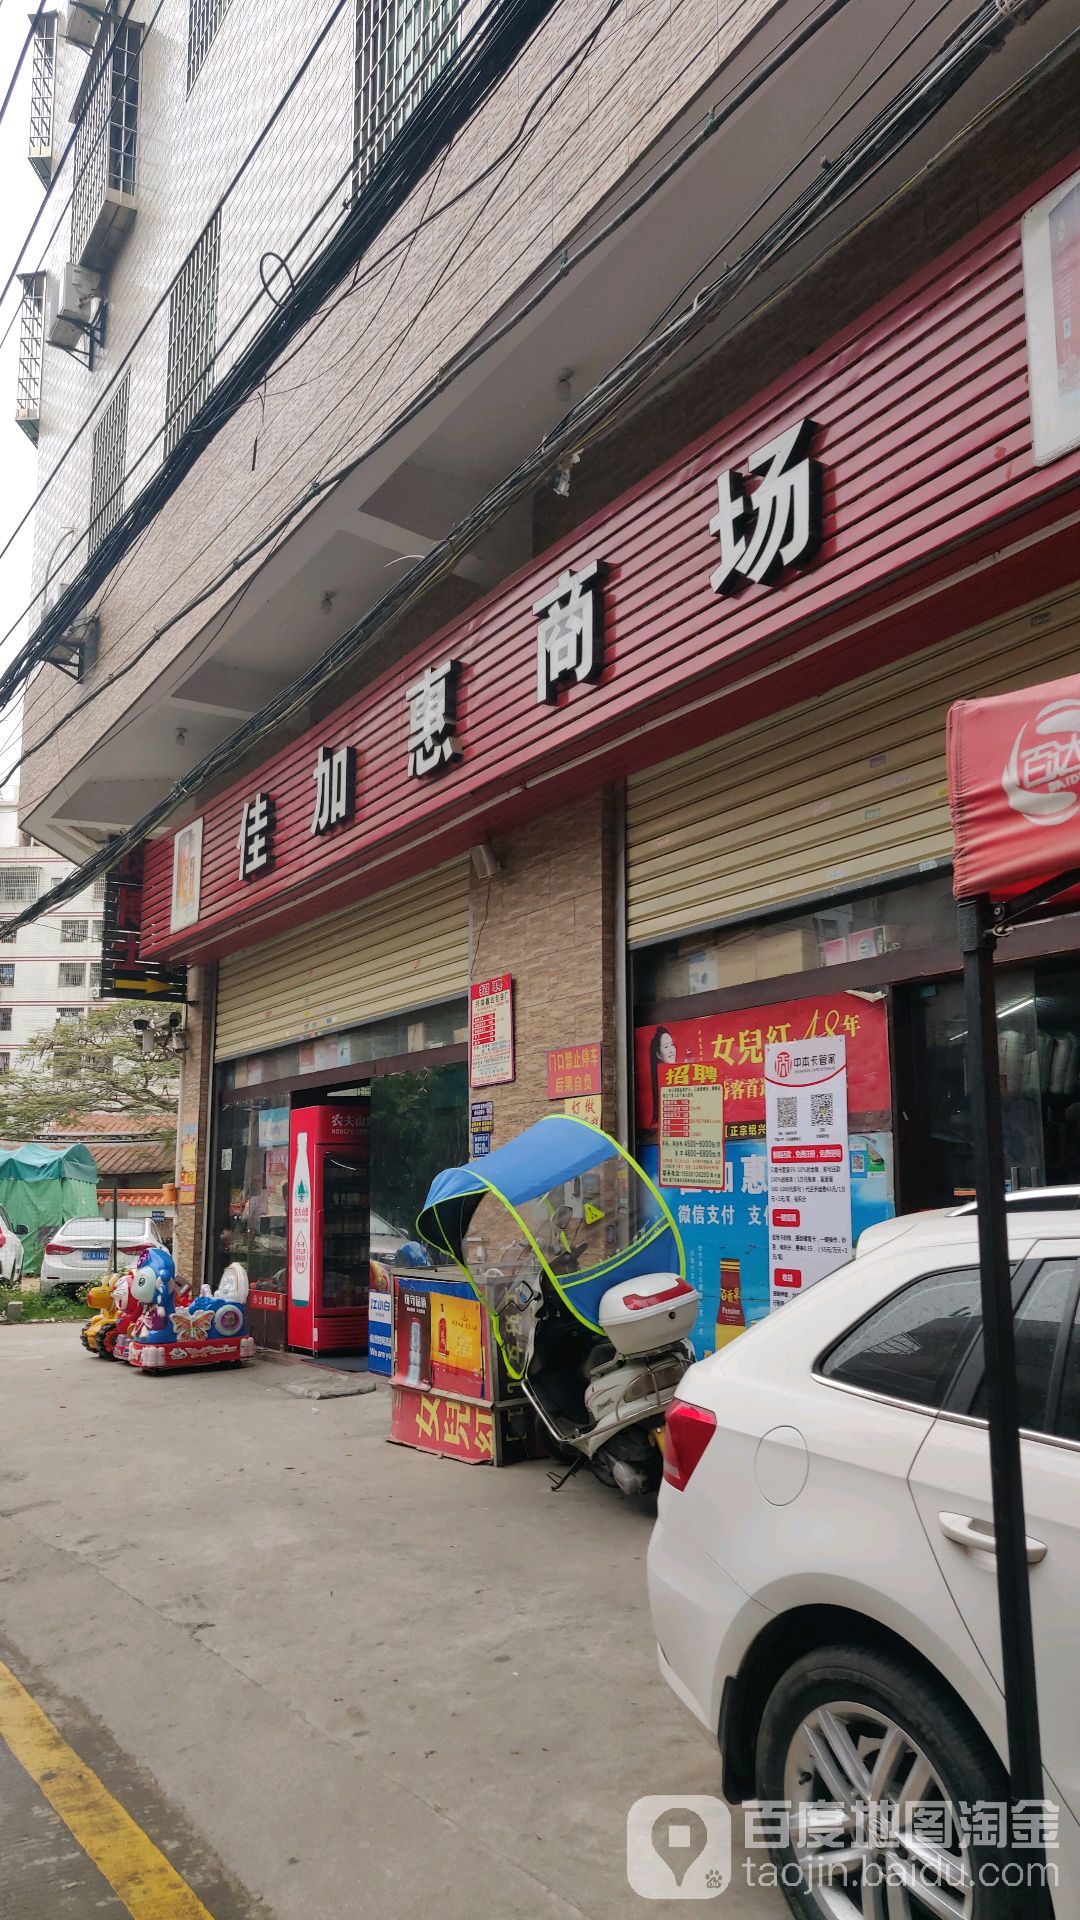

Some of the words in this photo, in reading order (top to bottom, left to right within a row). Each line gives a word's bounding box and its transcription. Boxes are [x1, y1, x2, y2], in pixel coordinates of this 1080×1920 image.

[236, 418, 823, 881] 佳加惠商场
[479, 978, 503, 997] 招聘
[548, 1047, 599, 1072] 门口禁止停车
[793, 1053, 836, 1068] 中本卡管家
[555, 1073, 592, 1093] 后果自负
[665, 1063, 718, 1085] 招聘
[678, 1205, 735, 1225] 微信支付
[370, 1298, 391, 1312] 江小白
